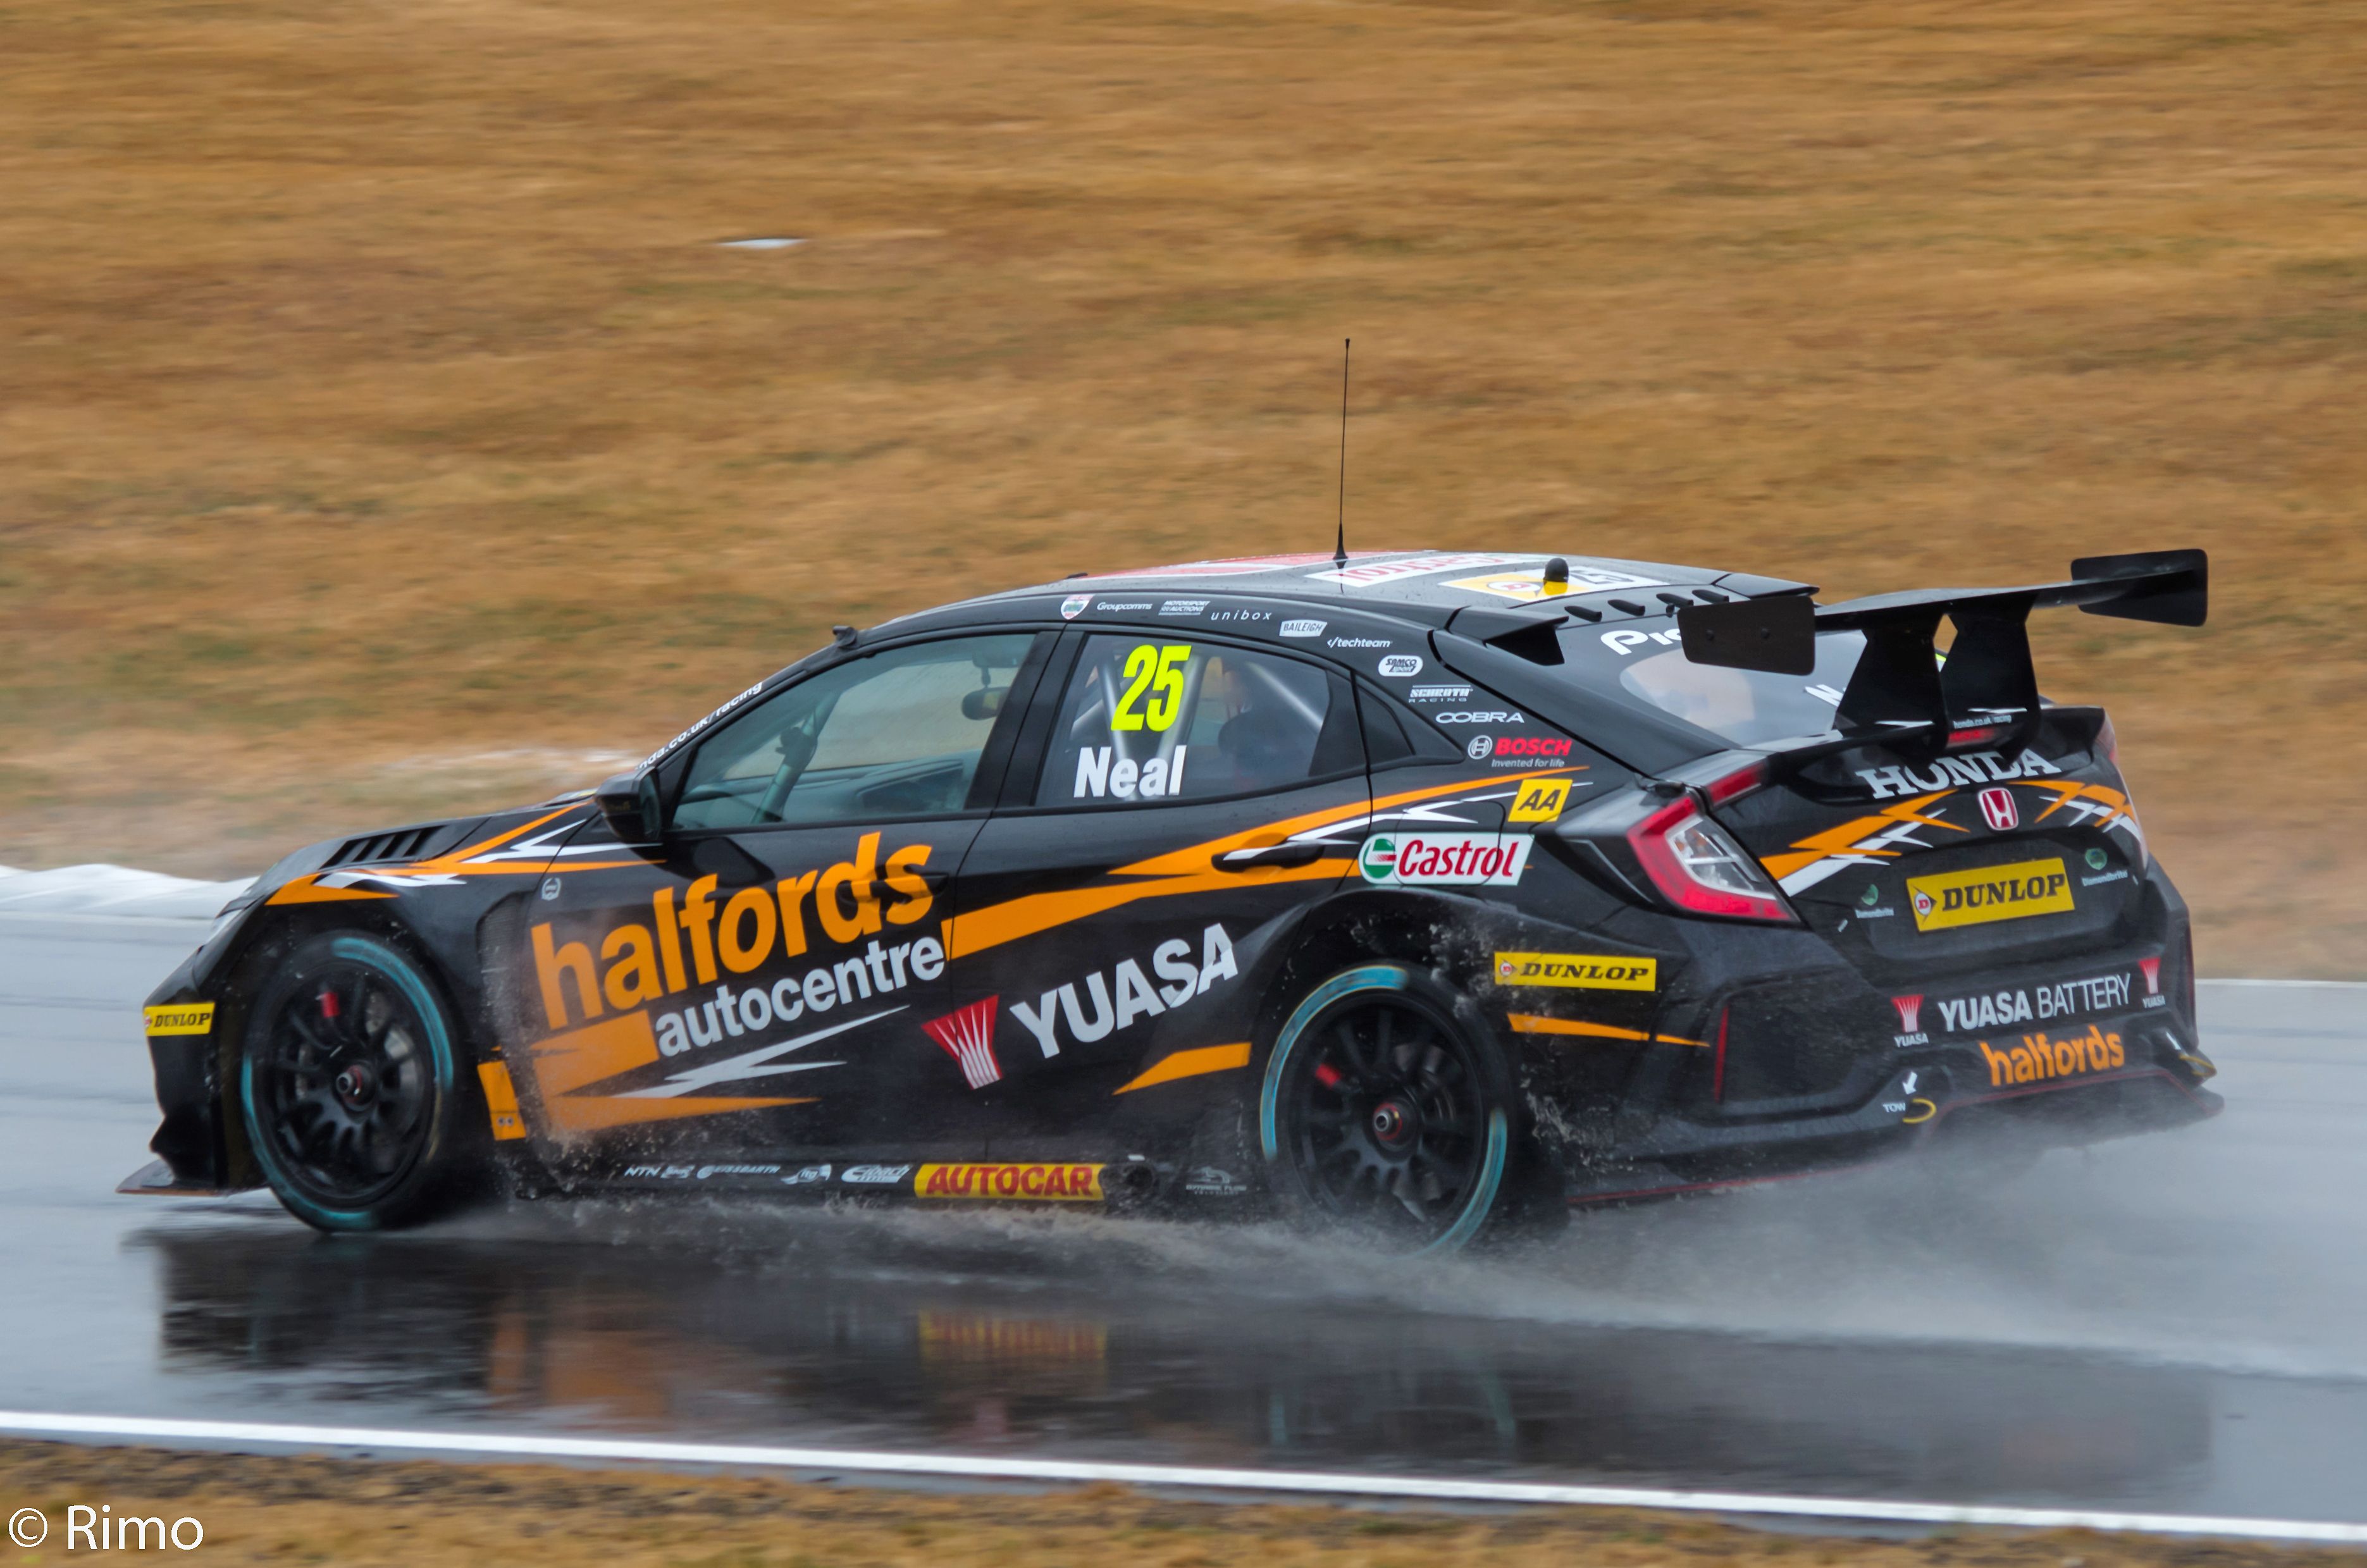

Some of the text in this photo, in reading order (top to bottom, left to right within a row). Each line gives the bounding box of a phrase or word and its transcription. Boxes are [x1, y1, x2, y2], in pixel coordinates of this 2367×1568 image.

[1097, 602, 1153, 612] Groupcomms
[1211, 609, 1272, 620] unibox
[1283, 623, 1323, 632] BAILEIGH
[1111, 645, 1192, 732] 25
[634, 681, 763, 770] nda.co.uk/racing
[1435, 711, 1525, 724] COBRA
[1494, 737, 1573, 756] BOSCH
[1073, 744, 1187, 799] Neal
[1491, 759, 1565, 768] Invented for life
[1518, 789, 1562, 812] AA
[1398, 840, 1519, 878] Castrol
[1942, 873, 2065, 912] DUNLOP
[531, 831, 934, 1031] halfords
[1520, 962, 1649, 981] DUNLOP
[655, 937, 945, 1058] autocentre
[1009, 923, 1239, 1059] YUASA
[2142, 994, 2166, 1009] YUASA
[1937, 973, 2131, 1032] YUASA BATTERY
[154, 1013, 211, 1028] DUNLOP
[1894, 1032, 1929, 1047] YUASA
[1979, 1025, 2125, 1087] halfords
[1882, 1102, 1907, 1113] TOW
[624, 1166, 661, 1176] NTN
[926, 1166, 1093, 1197] AUTOCAR
